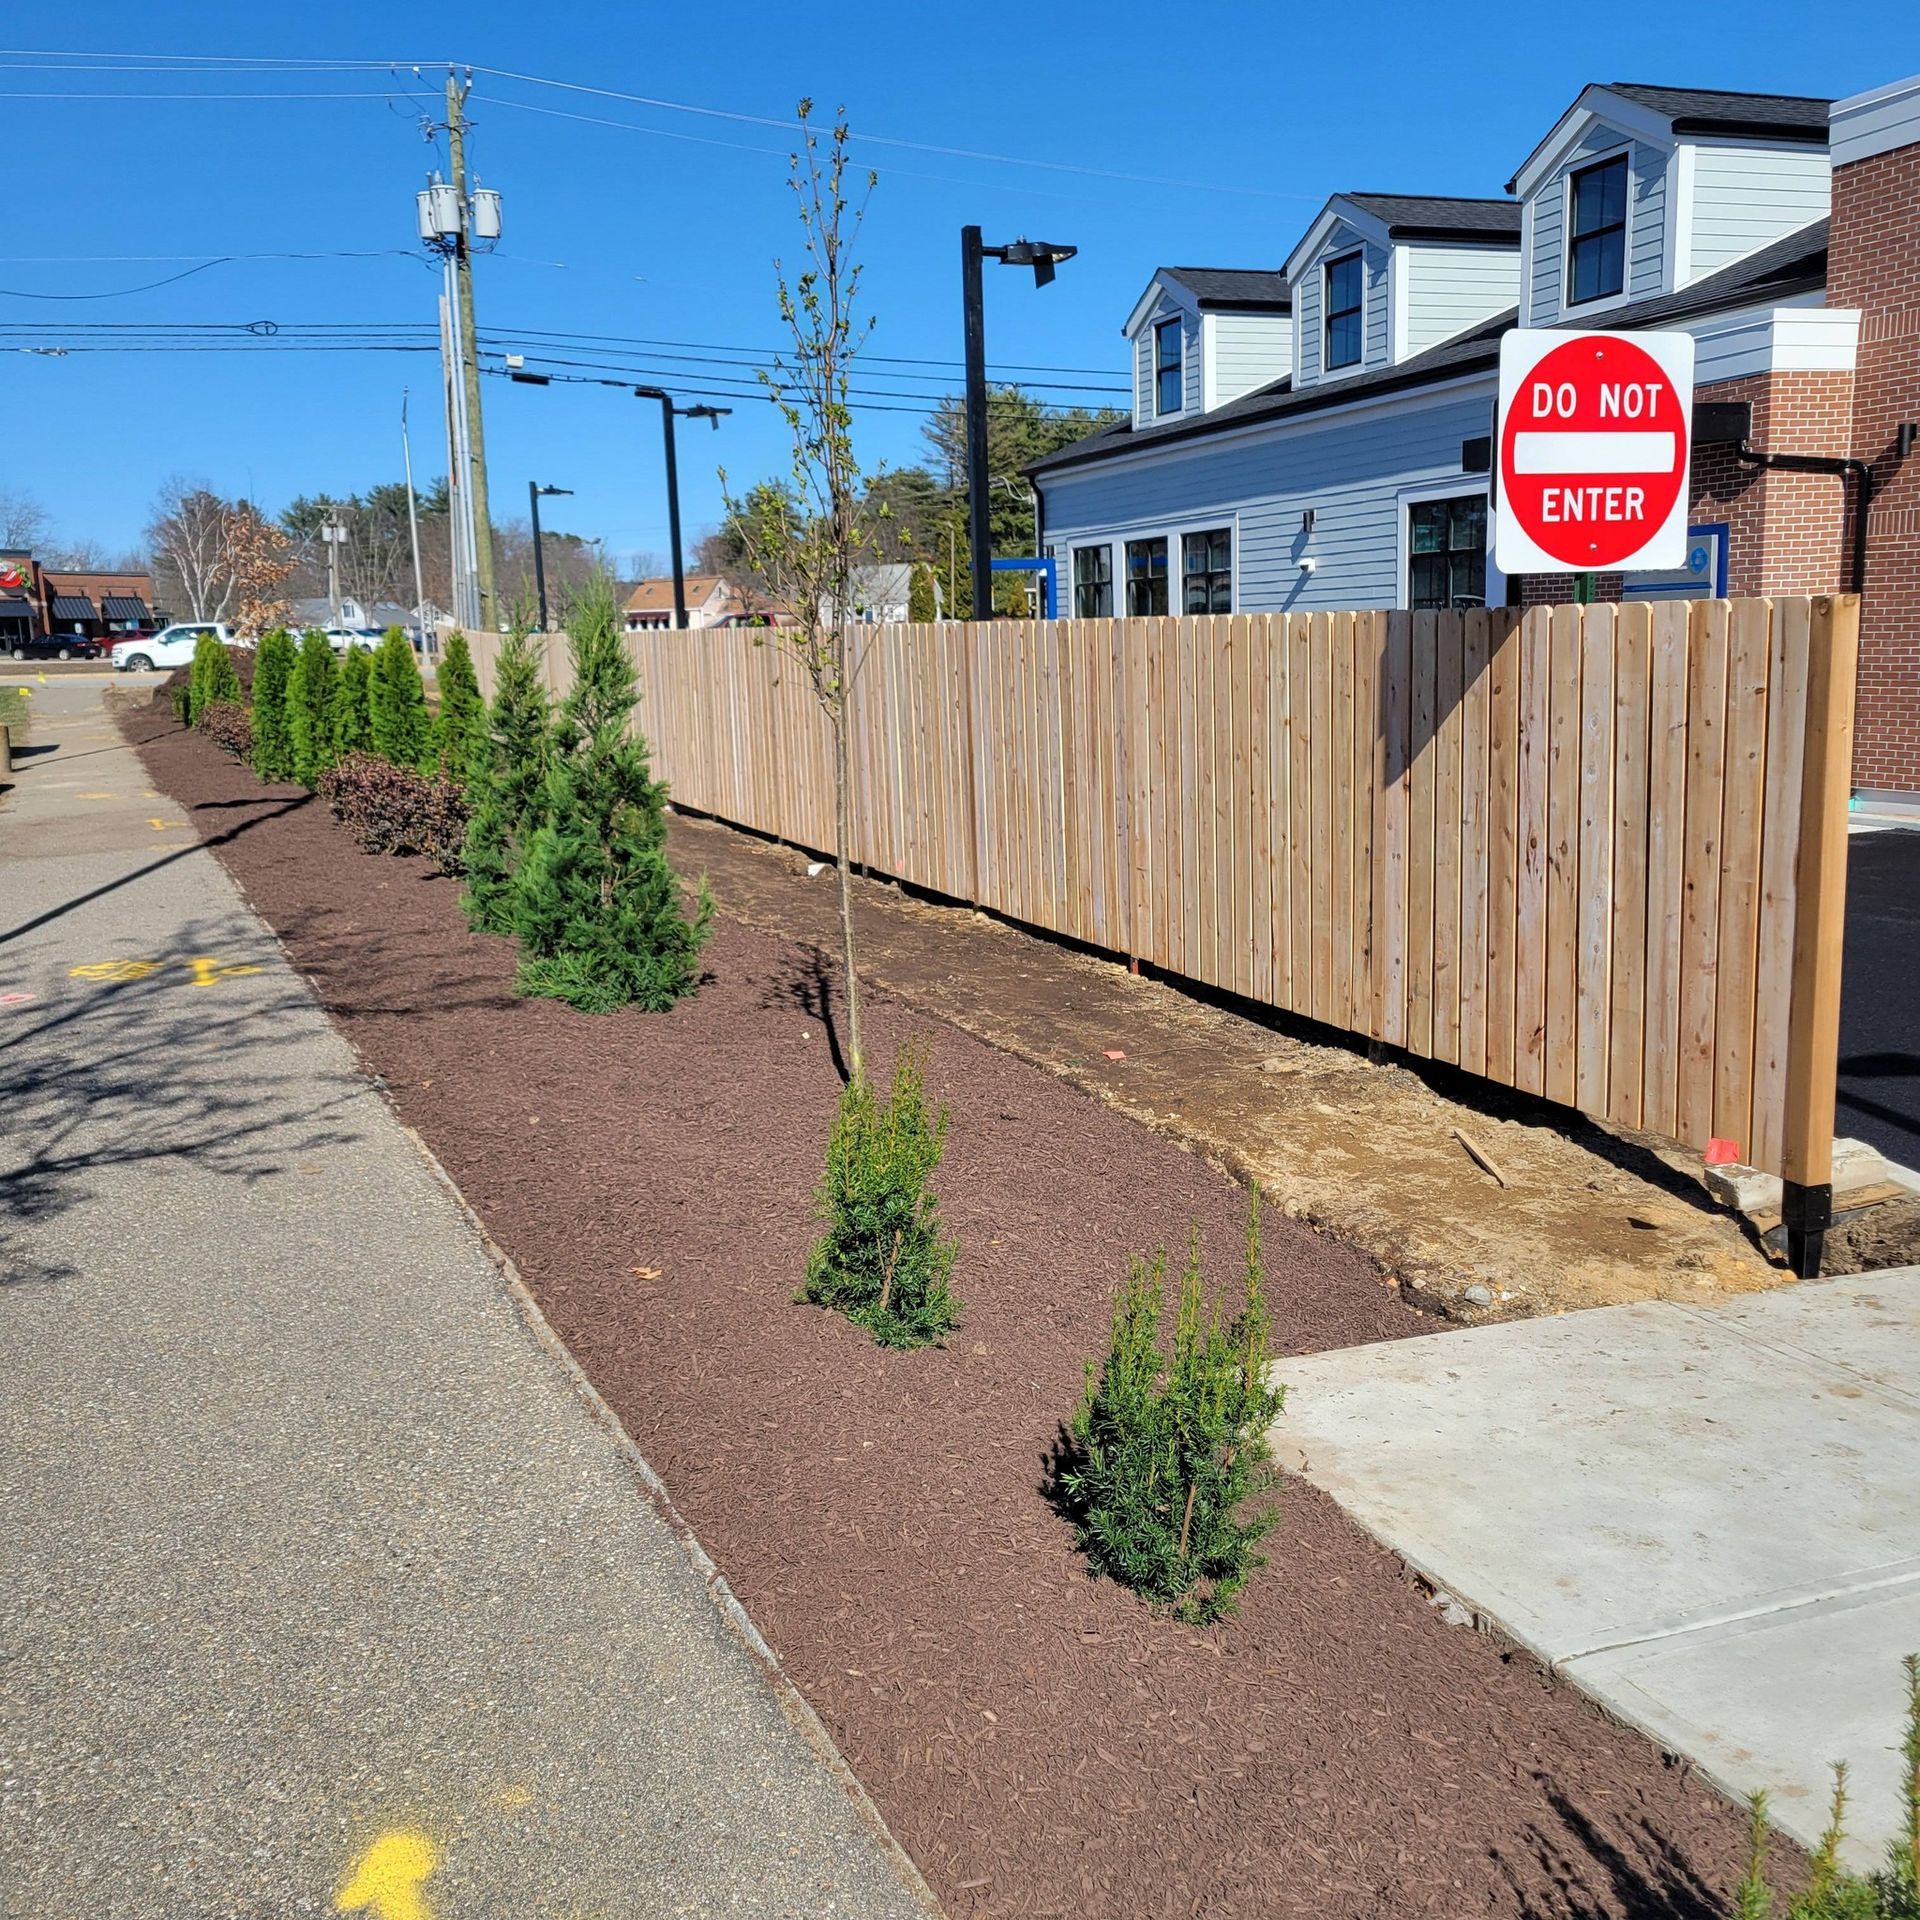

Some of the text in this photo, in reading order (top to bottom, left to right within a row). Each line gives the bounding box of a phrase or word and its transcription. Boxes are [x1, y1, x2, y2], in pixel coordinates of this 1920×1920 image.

[1533, 383, 1662, 417] DO NOT
[1543, 488, 1644, 522] ENTER
